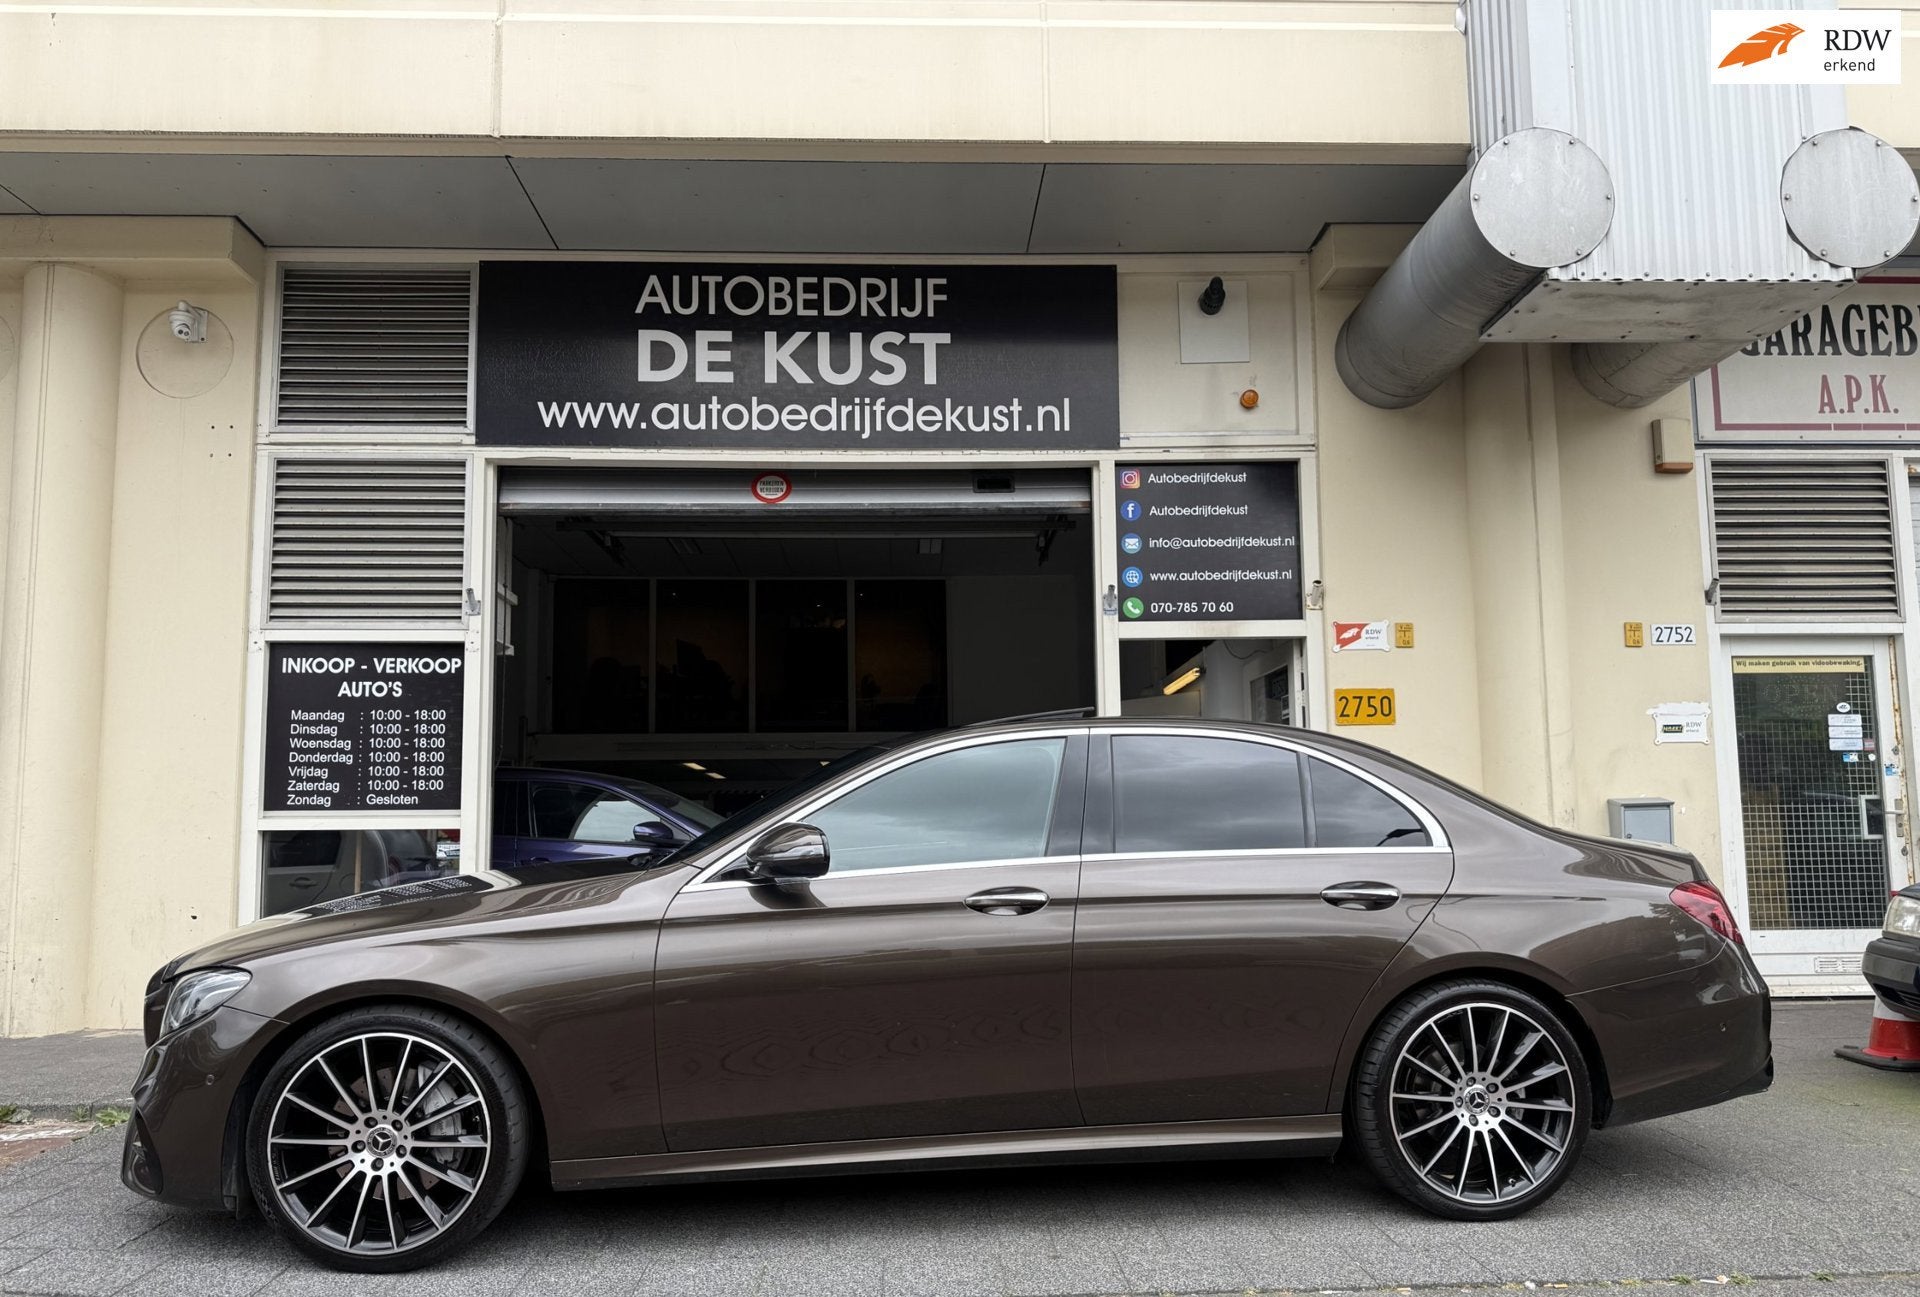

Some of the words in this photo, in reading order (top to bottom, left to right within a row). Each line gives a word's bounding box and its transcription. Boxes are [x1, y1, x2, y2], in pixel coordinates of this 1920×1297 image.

[634, 274, 948, 318] AUTOBEDRIJF
[1740, 304, 1920, 356] ARAGEB
[637, 329, 735, 384] DE
[764, 331, 952, 386] KUST
[1818, 374, 1899, 414] A.P.K.
[537, 395, 1071, 440] www.autobedrijfdekust.nl
[1147, 471, 1247, 484] Autobedrijfdekust
[1149, 504, 1248, 517] Autobedrijfdekust
[1149, 536, 1295, 549] info@autobedrijfdekust.nl
[1149, 569, 1292, 582] www.autobedrijfdekust.nl
[1150, 602, 1199, 614] 070-785
[1201, 602, 1216, 613] 70
[1218, 601, 1234, 613] 60
[1654, 626, 1694, 643] 2752
[281, 657, 356, 674] INKOOP
[372, 657, 462, 674] VERKOOP
[337, 680, 403, 698] AUTO'S
[1338, 695, 1392, 718] 2750
[291, 710, 345, 722] Maandag
[370, 710, 403, 721] 10:00
[415, 710, 447, 721] 18:00
[290, 724, 338, 736] Dinsdag
[369, 724, 402, 735] 10:00
[414, 724, 446, 735] 18:00
[290, 738, 352, 750] Woensdag
[368, 738, 401, 749] 10:00
[413, 738, 445, 749] 18:00
[289, 752, 354, 764] Donderdag
[368, 752, 401, 763] 10:00
[413, 752, 445, 763] 18:00
[288, 766, 329, 779] Vrijdag
[367, 766, 400, 777] 10:00
[412, 766, 444, 777] 18:00
[287, 780, 341, 793] Zaterdag
[366, 780, 399, 791] 10:00
[412, 780, 444, 791] 18:00
[287, 794, 332, 807] Zondag
[366, 794, 419, 805] Gesloten
